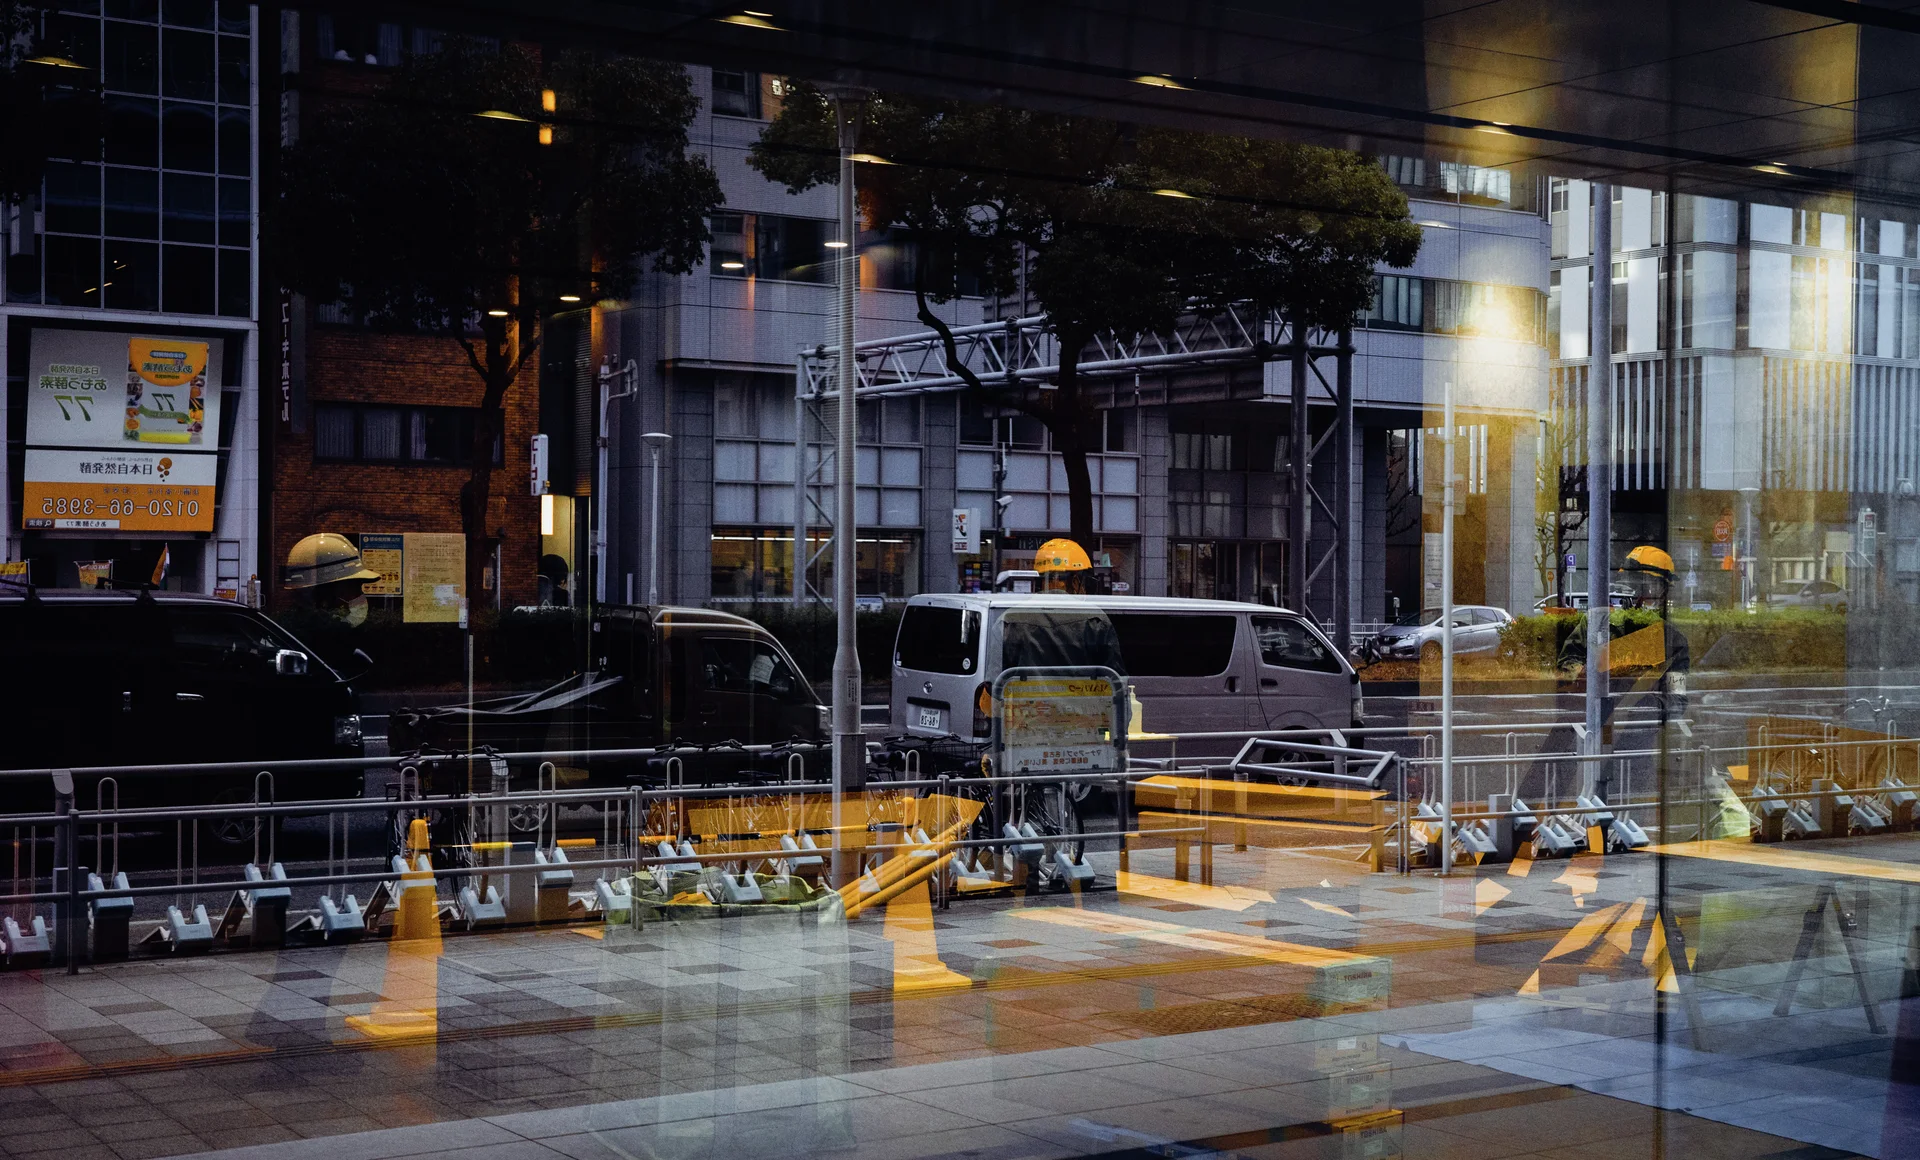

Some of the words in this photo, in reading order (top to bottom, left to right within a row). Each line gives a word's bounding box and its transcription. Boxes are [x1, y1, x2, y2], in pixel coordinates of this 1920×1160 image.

[1343, 971, 1373, 982] TOSHIBA
[1346, 1073, 1374, 1085] TOSHIBA
[1360, 1127, 1387, 1138] TOSHIBA
